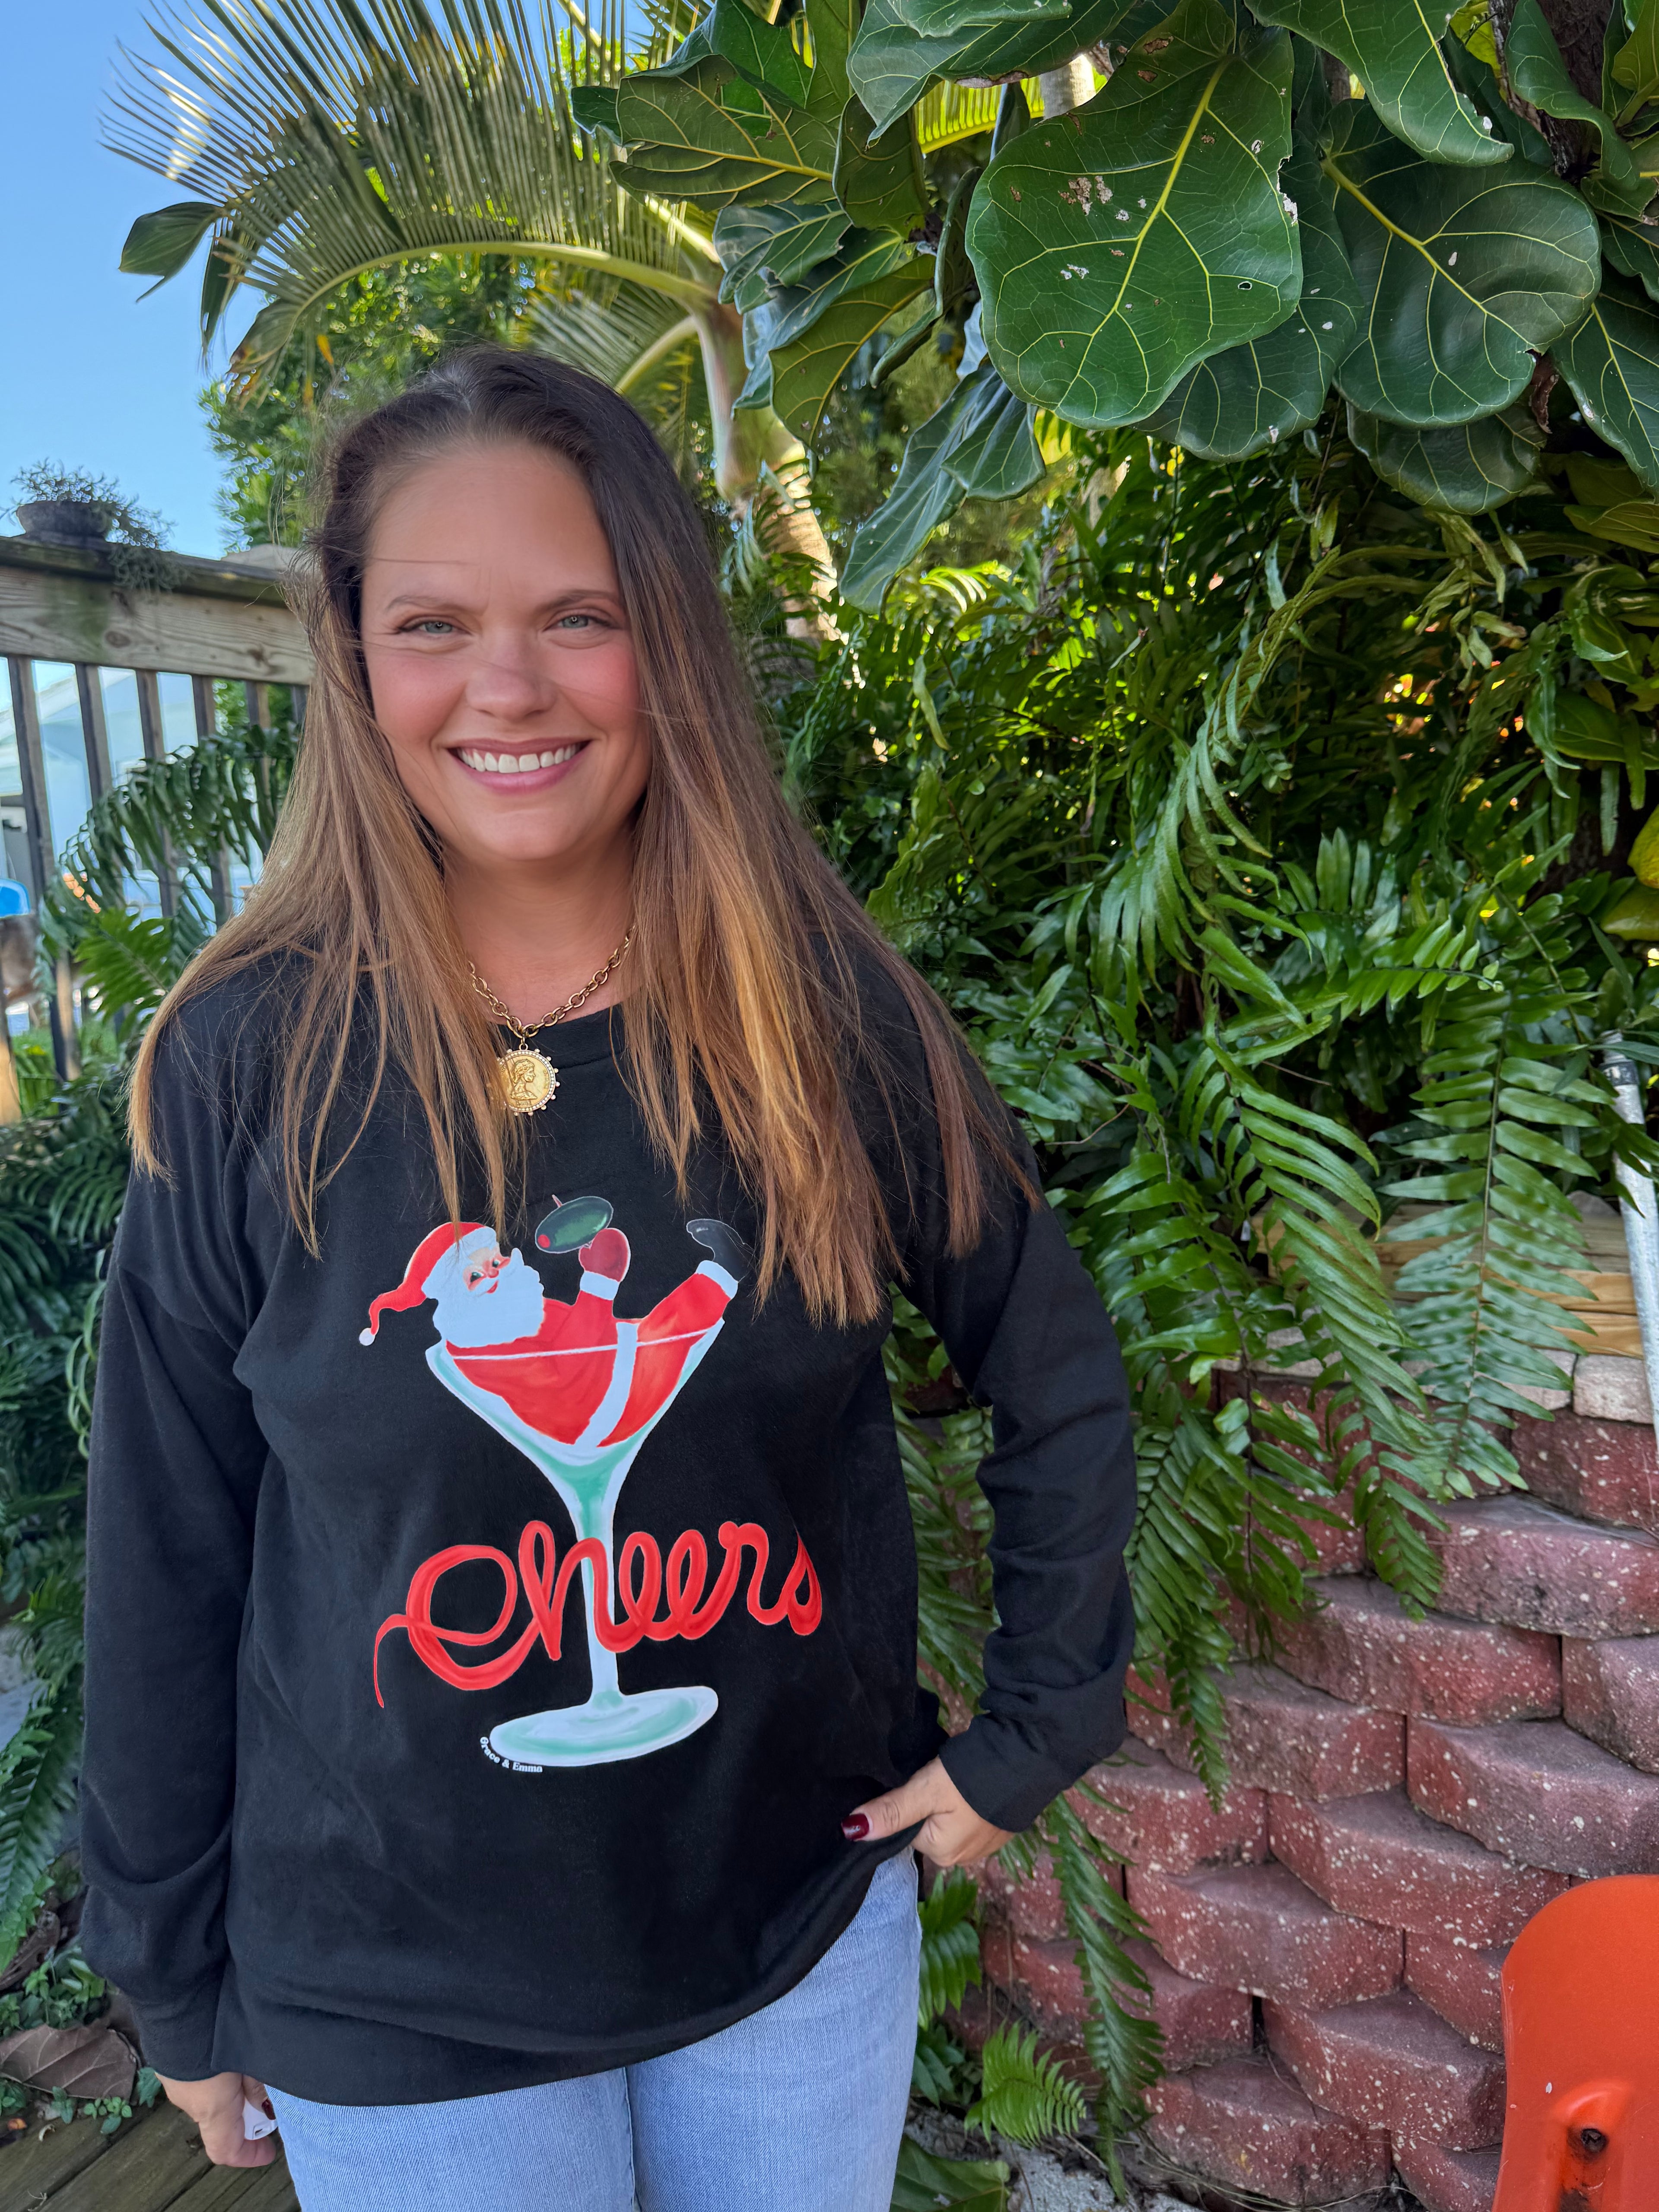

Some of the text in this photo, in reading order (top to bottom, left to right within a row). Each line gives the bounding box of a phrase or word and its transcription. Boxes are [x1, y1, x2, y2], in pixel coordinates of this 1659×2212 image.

[374, 1521, 822, 1708] Cheers
[480, 1737, 543, 1773] Grace & Emma
